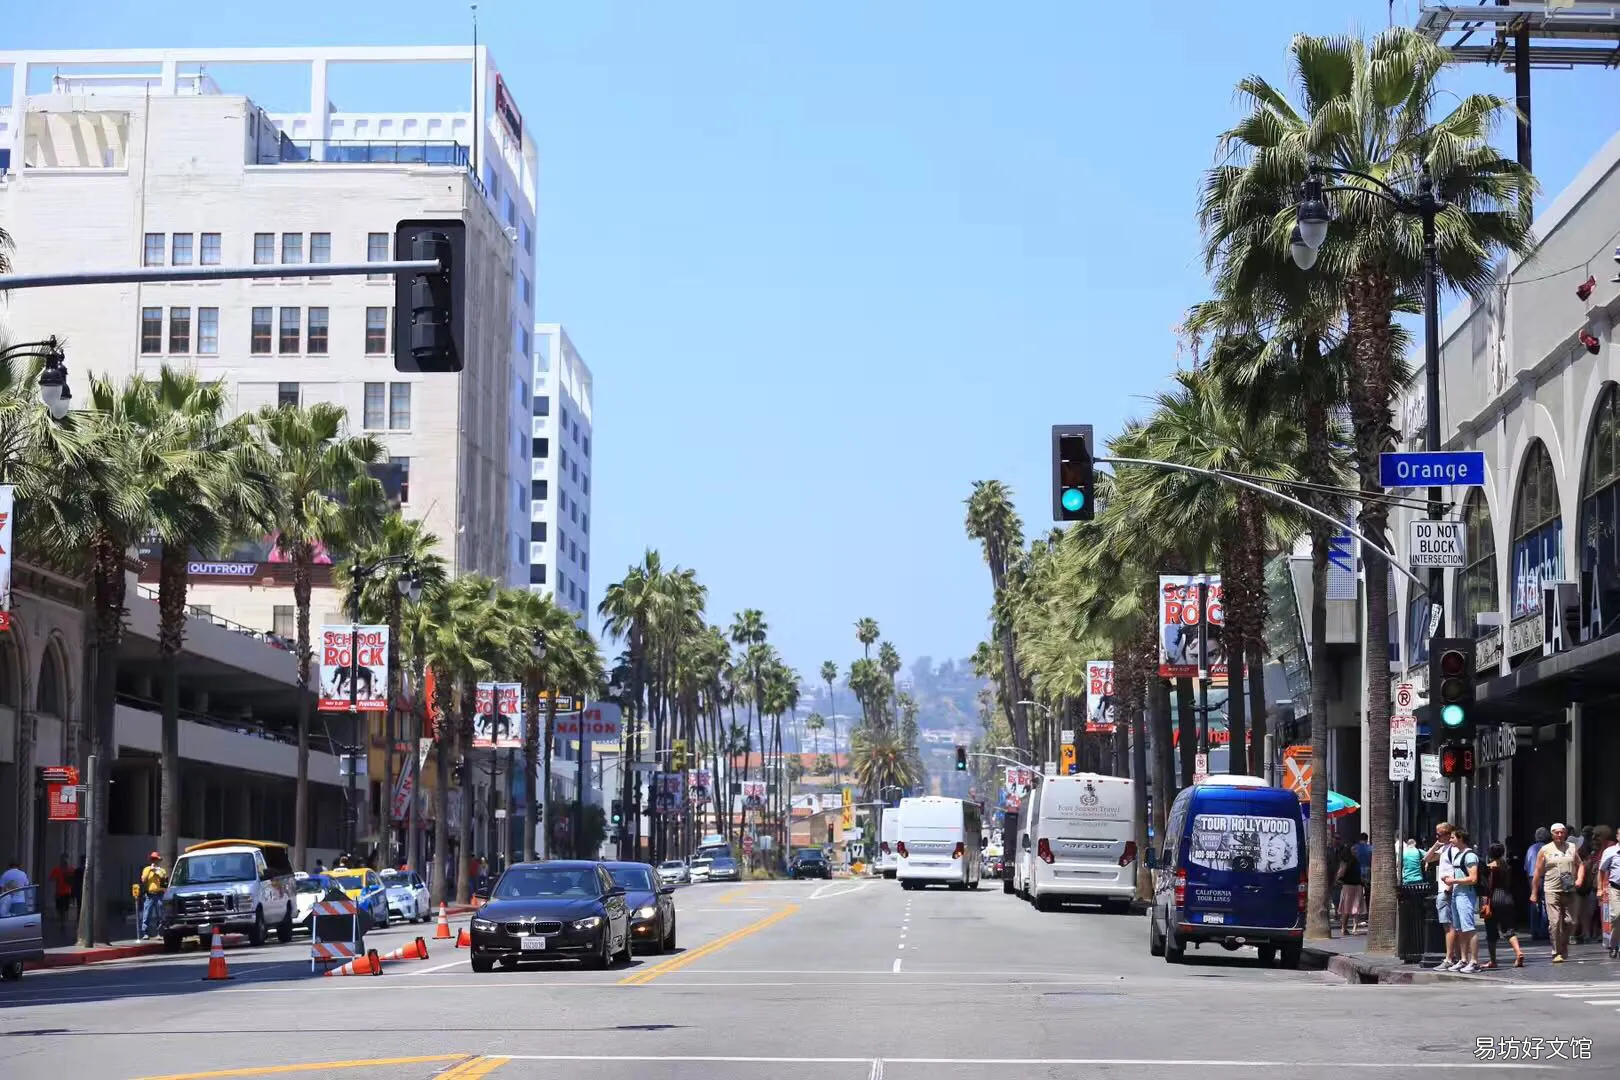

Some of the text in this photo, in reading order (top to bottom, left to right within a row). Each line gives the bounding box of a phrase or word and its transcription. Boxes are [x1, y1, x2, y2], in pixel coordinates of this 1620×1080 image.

[1397, 461, 1468, 482] Orange
[1417, 525, 1457, 538] DO NOT
[1420, 540, 1455, 553] BLOCK
[1412, 554, 1463, 564] INTERSECTION
[190, 562, 254, 574] OUTFRONT
[1165, 601, 1225, 625] ROC
[323, 647, 385, 668] ROCK
[1202, 817, 1289, 834] TOUR HOLLYWOOD
[1195, 889, 1232, 897] CALIFORNIA
